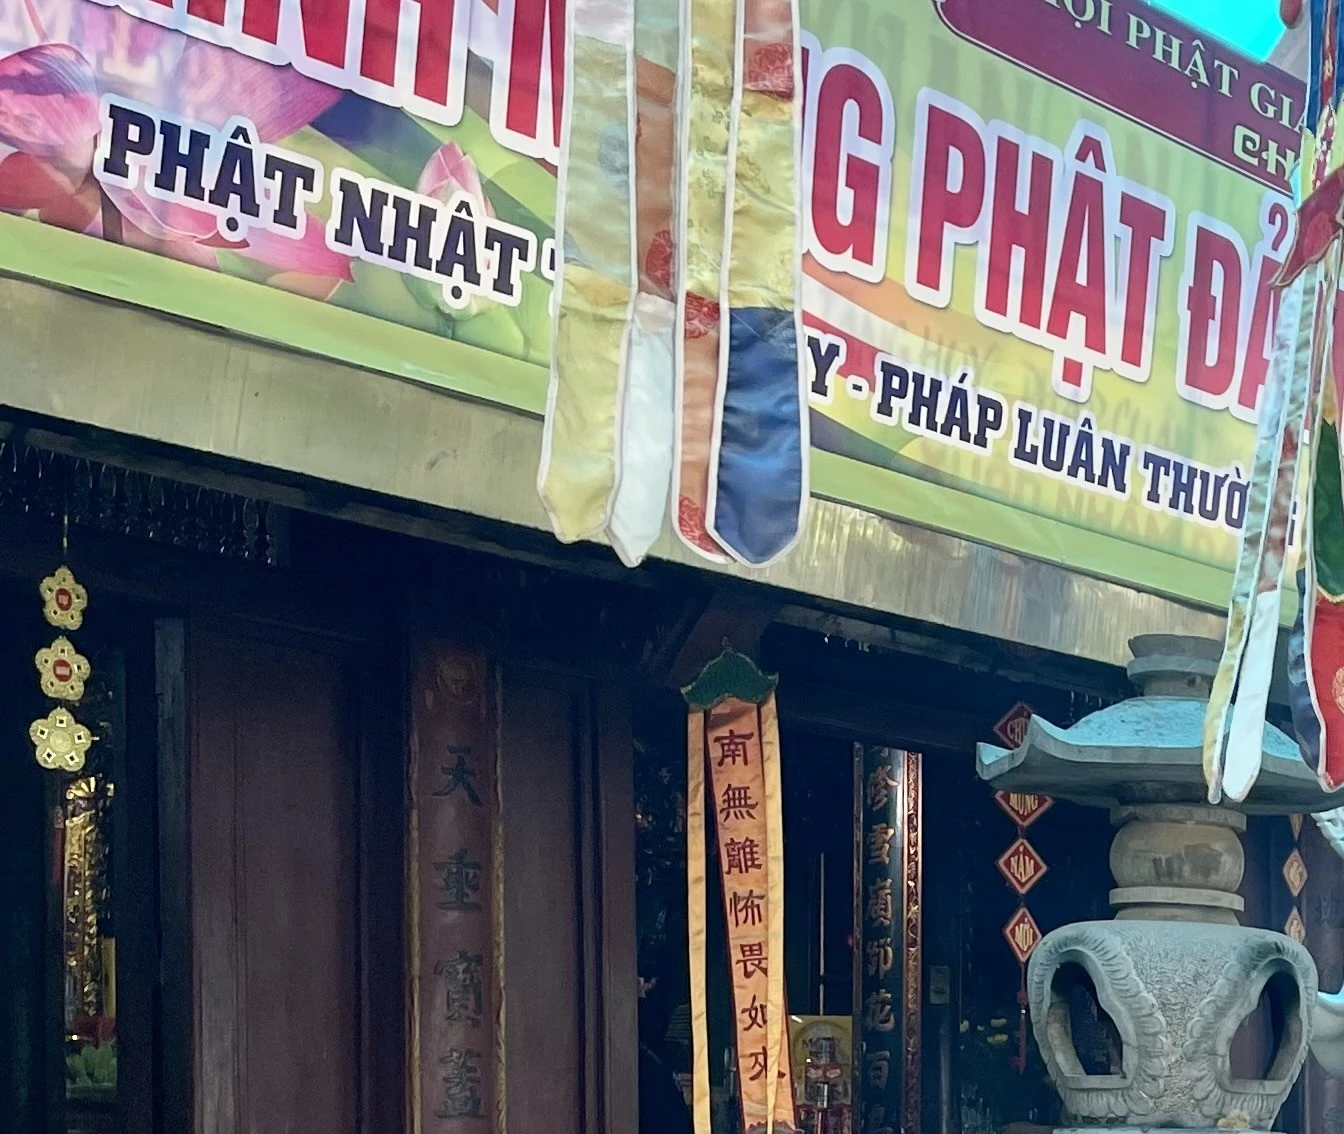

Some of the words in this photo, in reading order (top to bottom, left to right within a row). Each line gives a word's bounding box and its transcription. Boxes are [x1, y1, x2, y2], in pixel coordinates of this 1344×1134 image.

[1041, 0, 1113, 35] ỘI
[1126, 12, 1240, 98] PHẬT
[1250, 83, 1307, 133] GI
[103, 103, 316, 233] PHẬT
[334, 177, 529, 301] NHẬT
[916, 103, 1168, 388] PHẬT
[876, 361, 1002, 449] PHÁP
[1014, 410, 1131, 493] LUÂN
[1143, 451, 1297, 546] THƯỜ
[1007, 712, 1029, 748] CH
